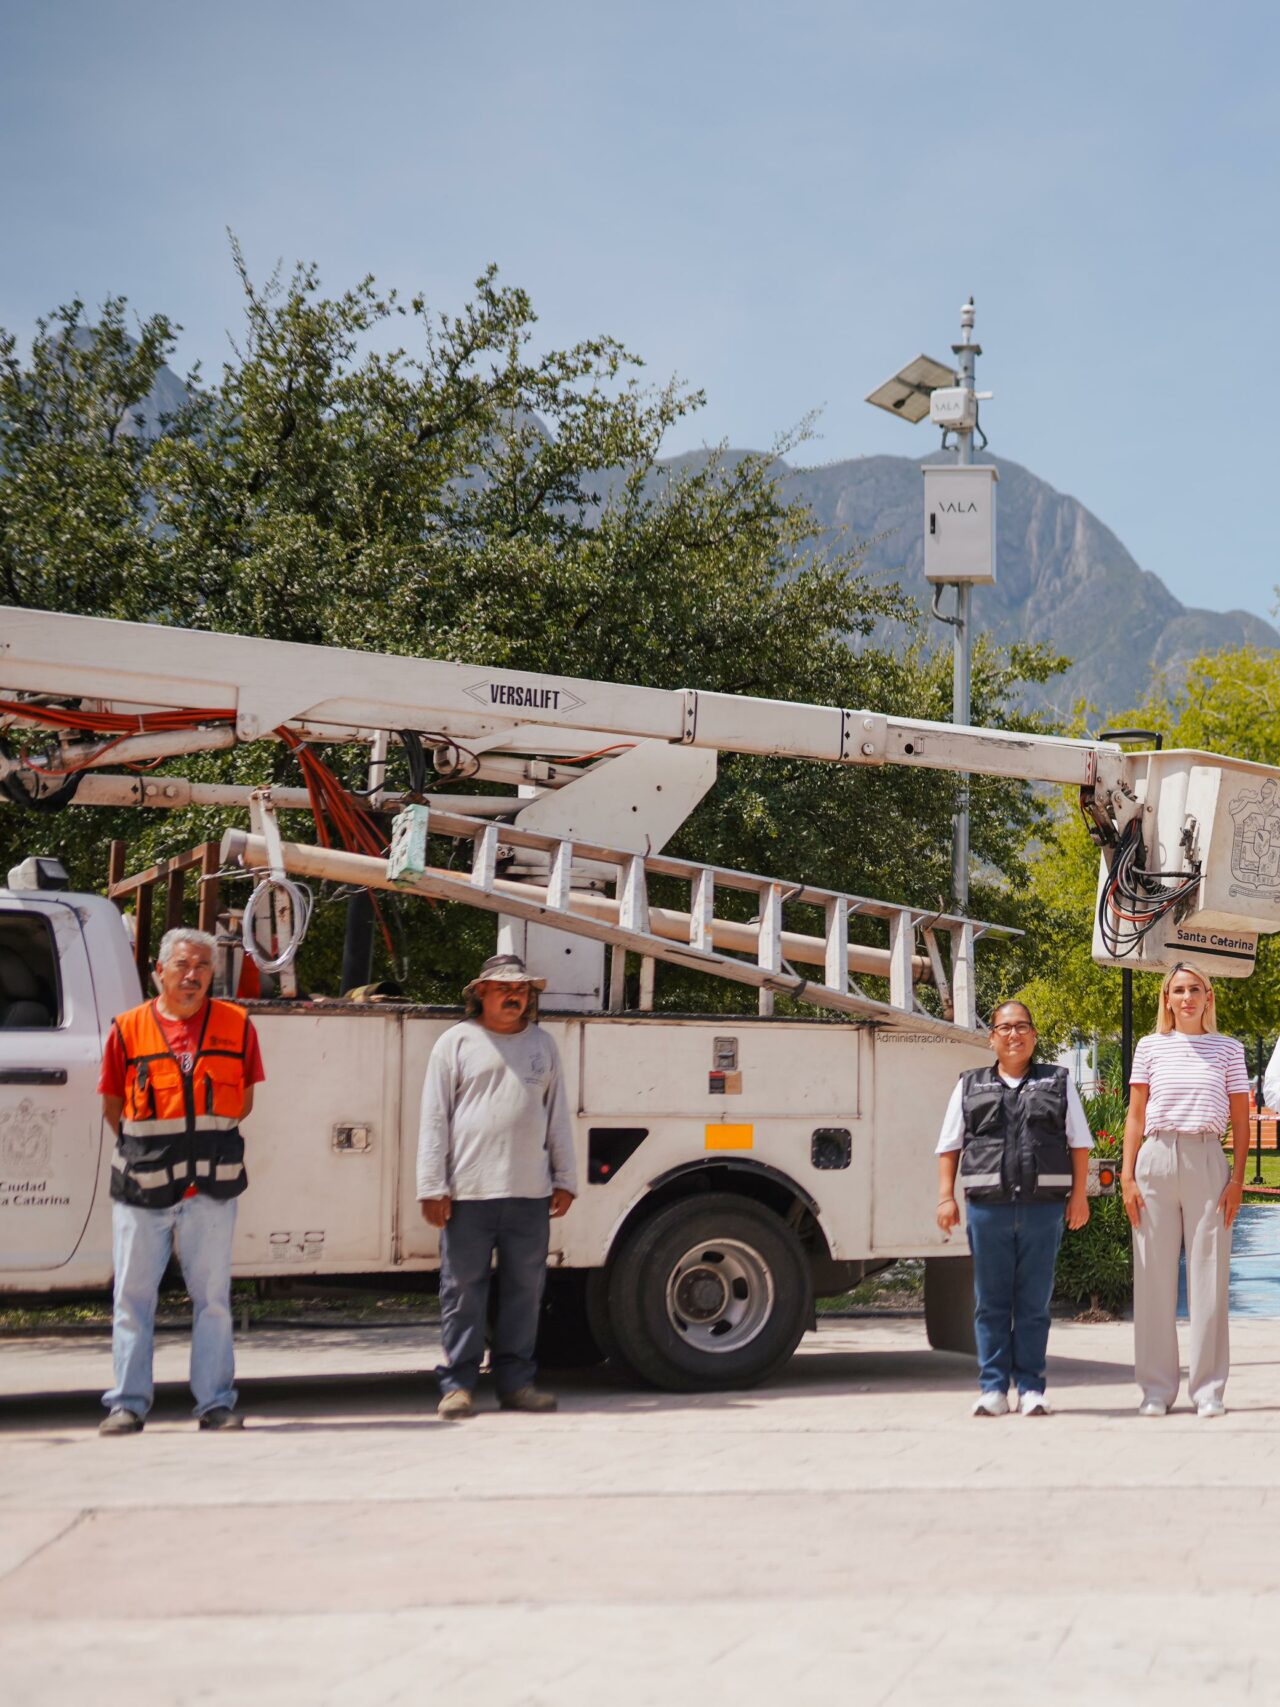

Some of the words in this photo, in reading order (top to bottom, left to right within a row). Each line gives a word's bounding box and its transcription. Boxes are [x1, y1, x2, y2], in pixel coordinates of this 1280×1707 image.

[490, 684, 560, 709] VERSALIFT
[1177, 929, 1207, 943] Santa
[1210, 934, 1254, 951] Catarina
[0, 1181, 46, 1192] Ciudad
[13, 1195, 71, 1205] Catarina
